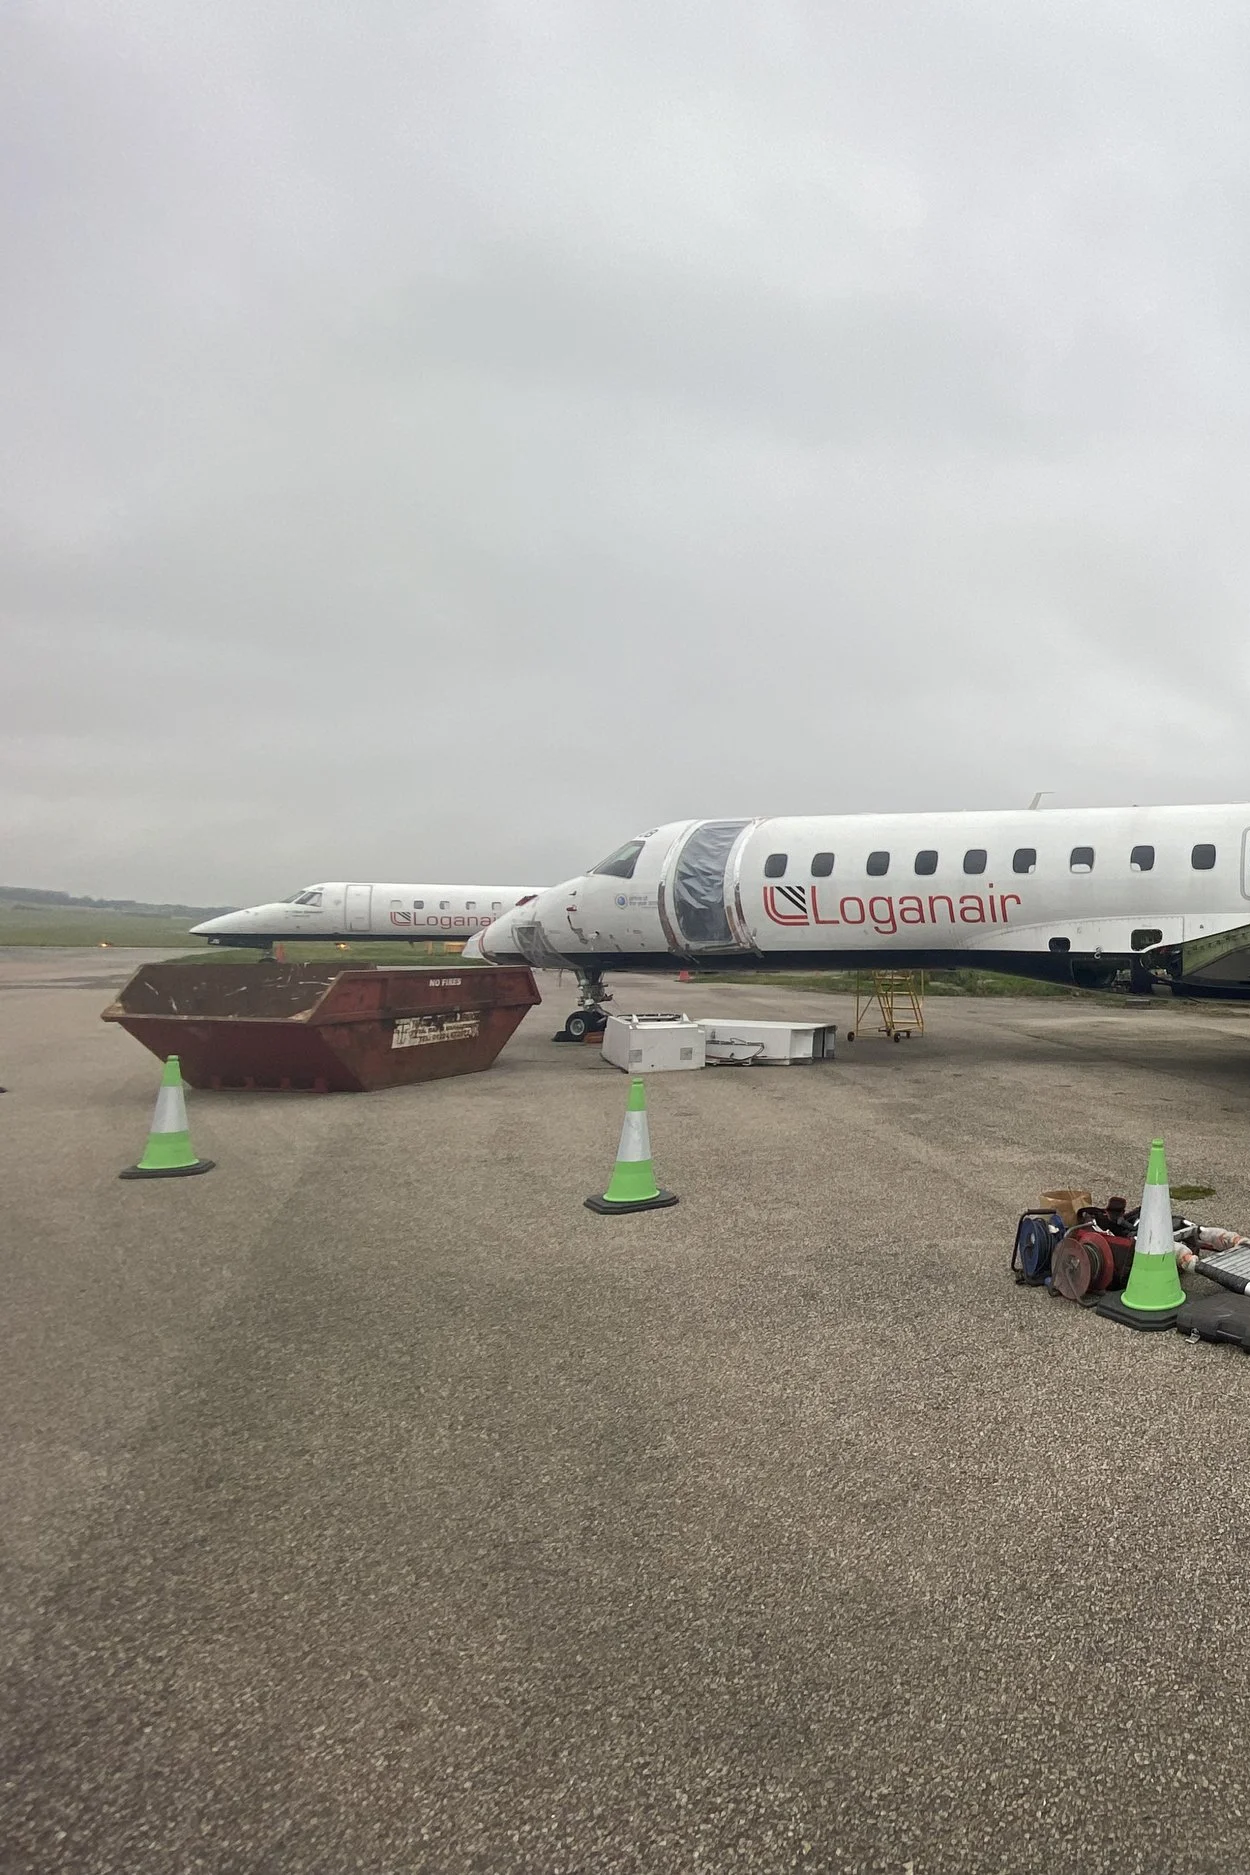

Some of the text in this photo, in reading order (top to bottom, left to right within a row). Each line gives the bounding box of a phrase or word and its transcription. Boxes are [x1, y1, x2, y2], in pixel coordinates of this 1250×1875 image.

[811, 883, 1022, 935] Loganair
[413, 912, 499, 929] Loganai
[429, 979, 440, 987] NO
